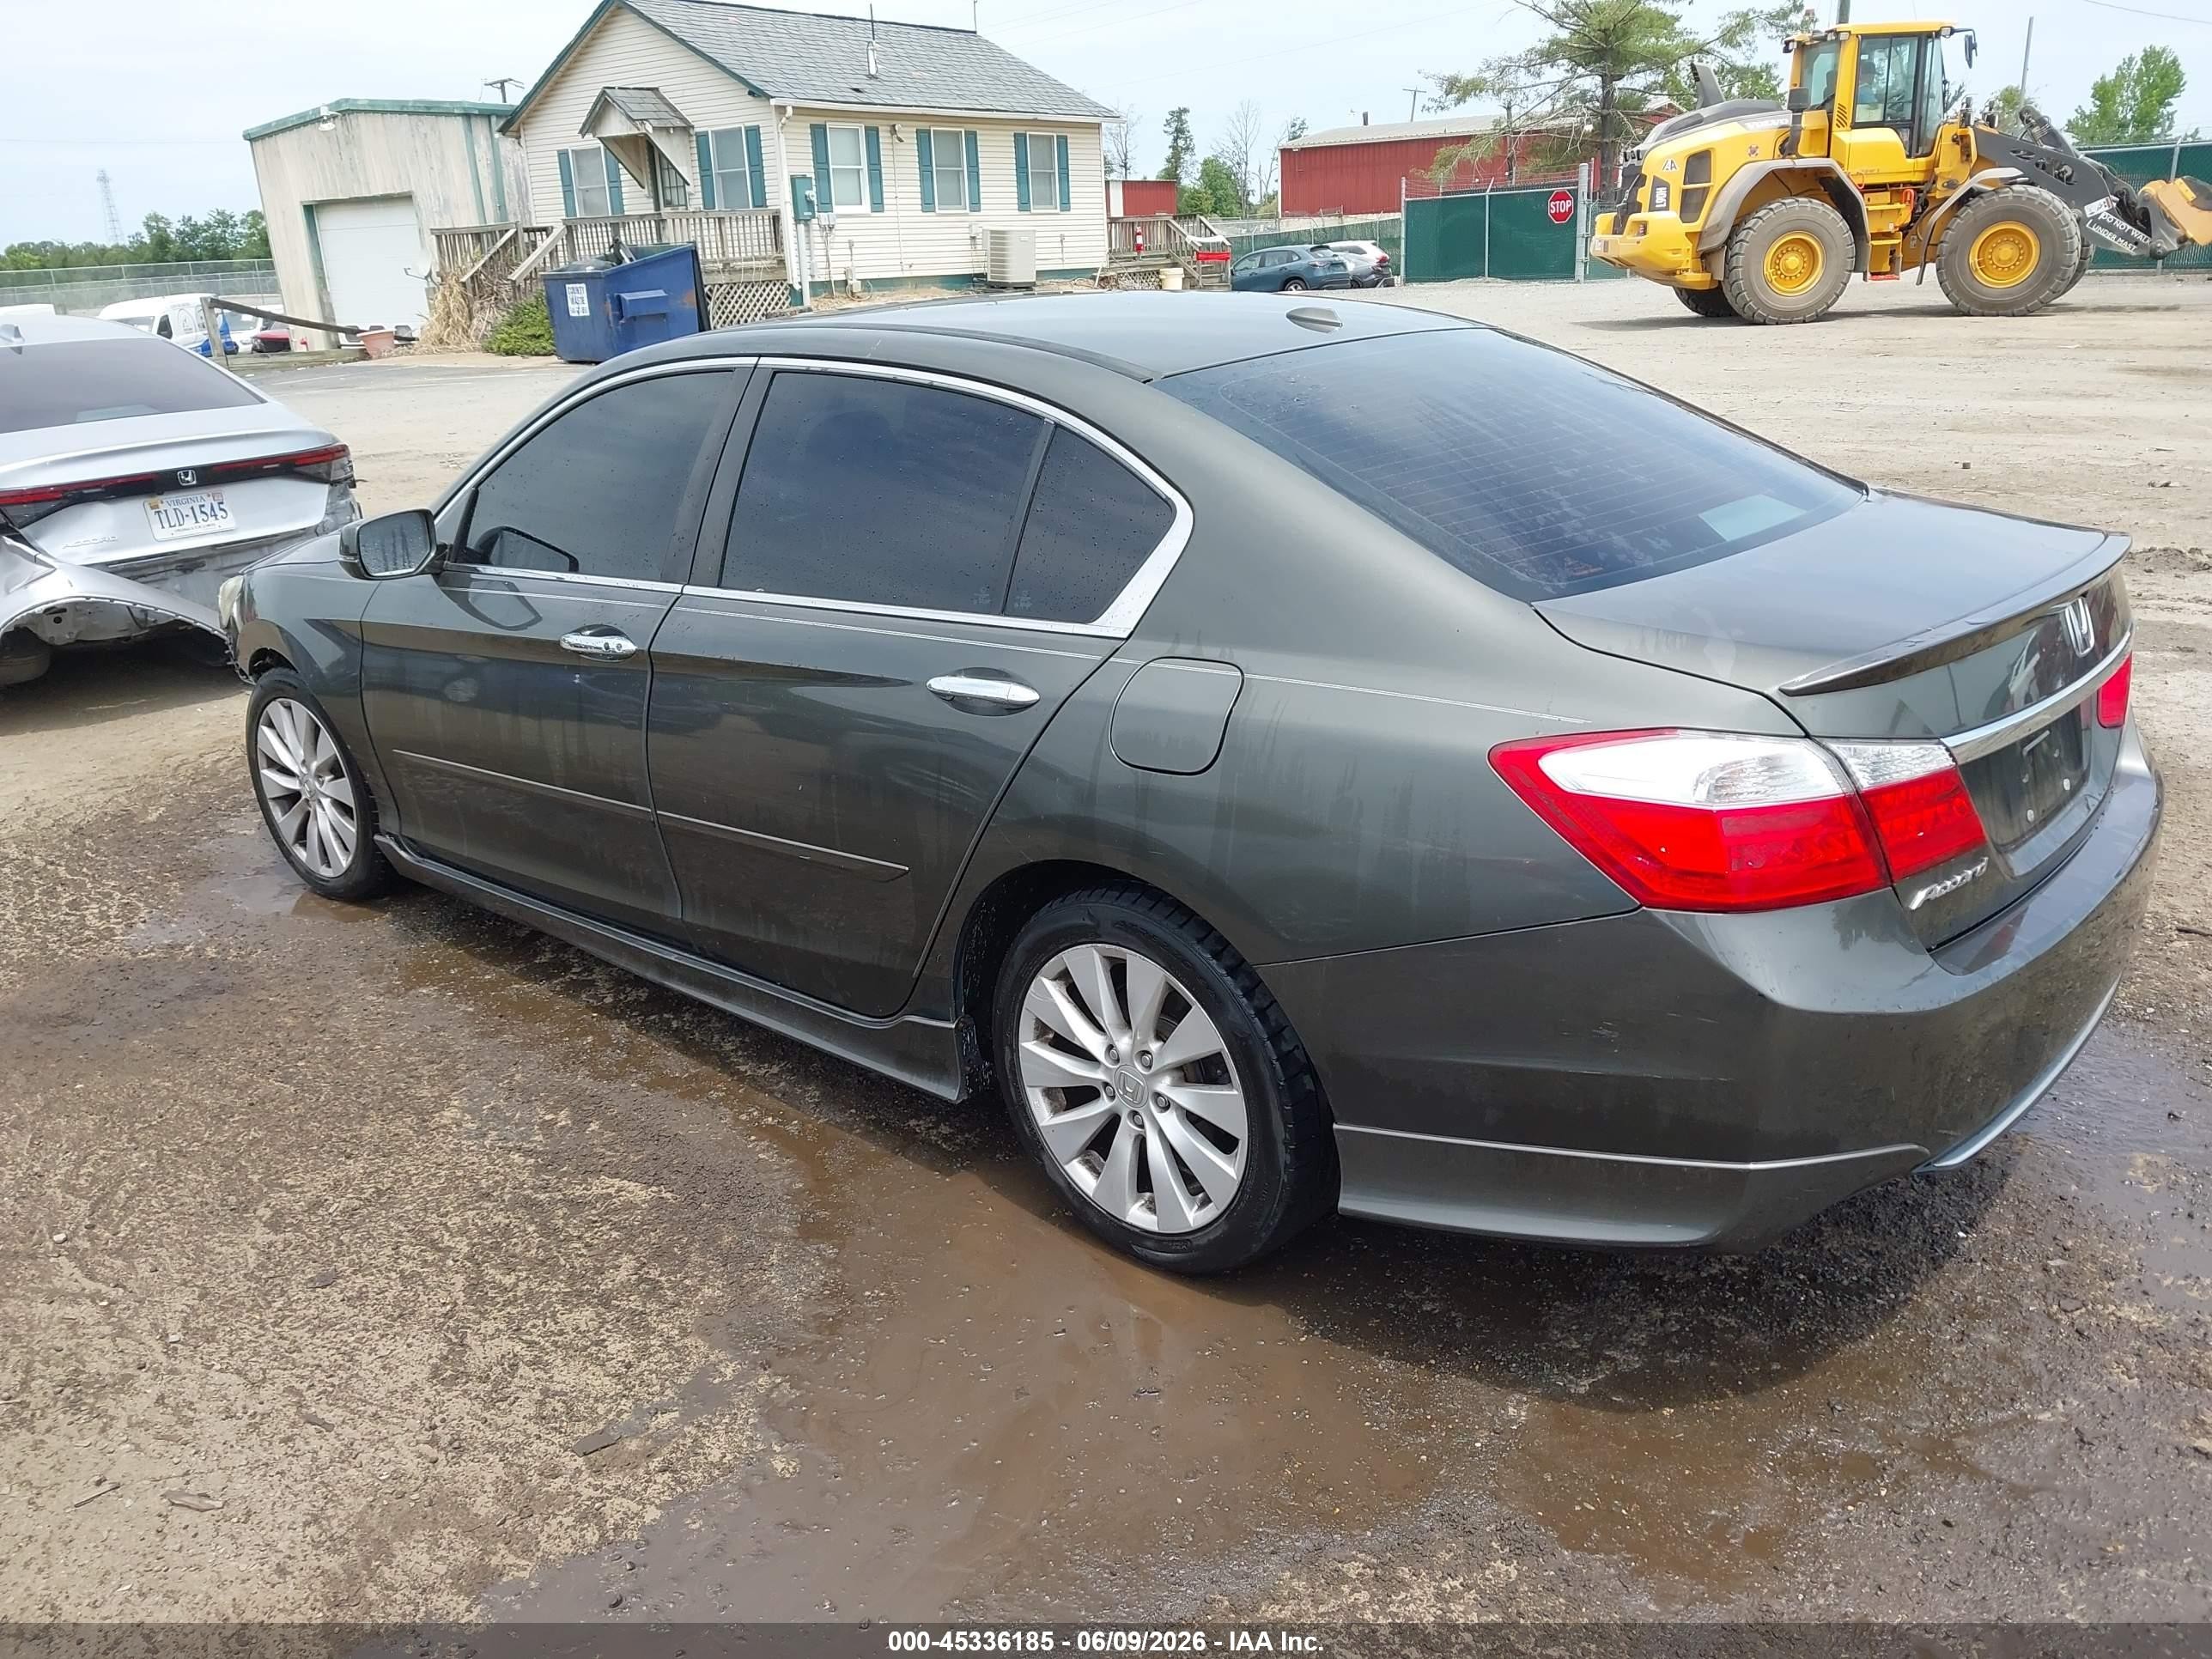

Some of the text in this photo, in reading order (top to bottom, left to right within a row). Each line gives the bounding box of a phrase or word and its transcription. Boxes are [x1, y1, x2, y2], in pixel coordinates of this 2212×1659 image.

[1550, 199, 1571, 214] STOP
[1655, 186, 1667, 208] L90H
[2092, 223, 2138, 252] UNDER MAST
[2113, 220, 2130, 233] NOT
[166, 495, 206, 507] VIRGINIA
[155, 501, 228, 530] TLD-1545
[1909, 857, 1989, 910] Accord
